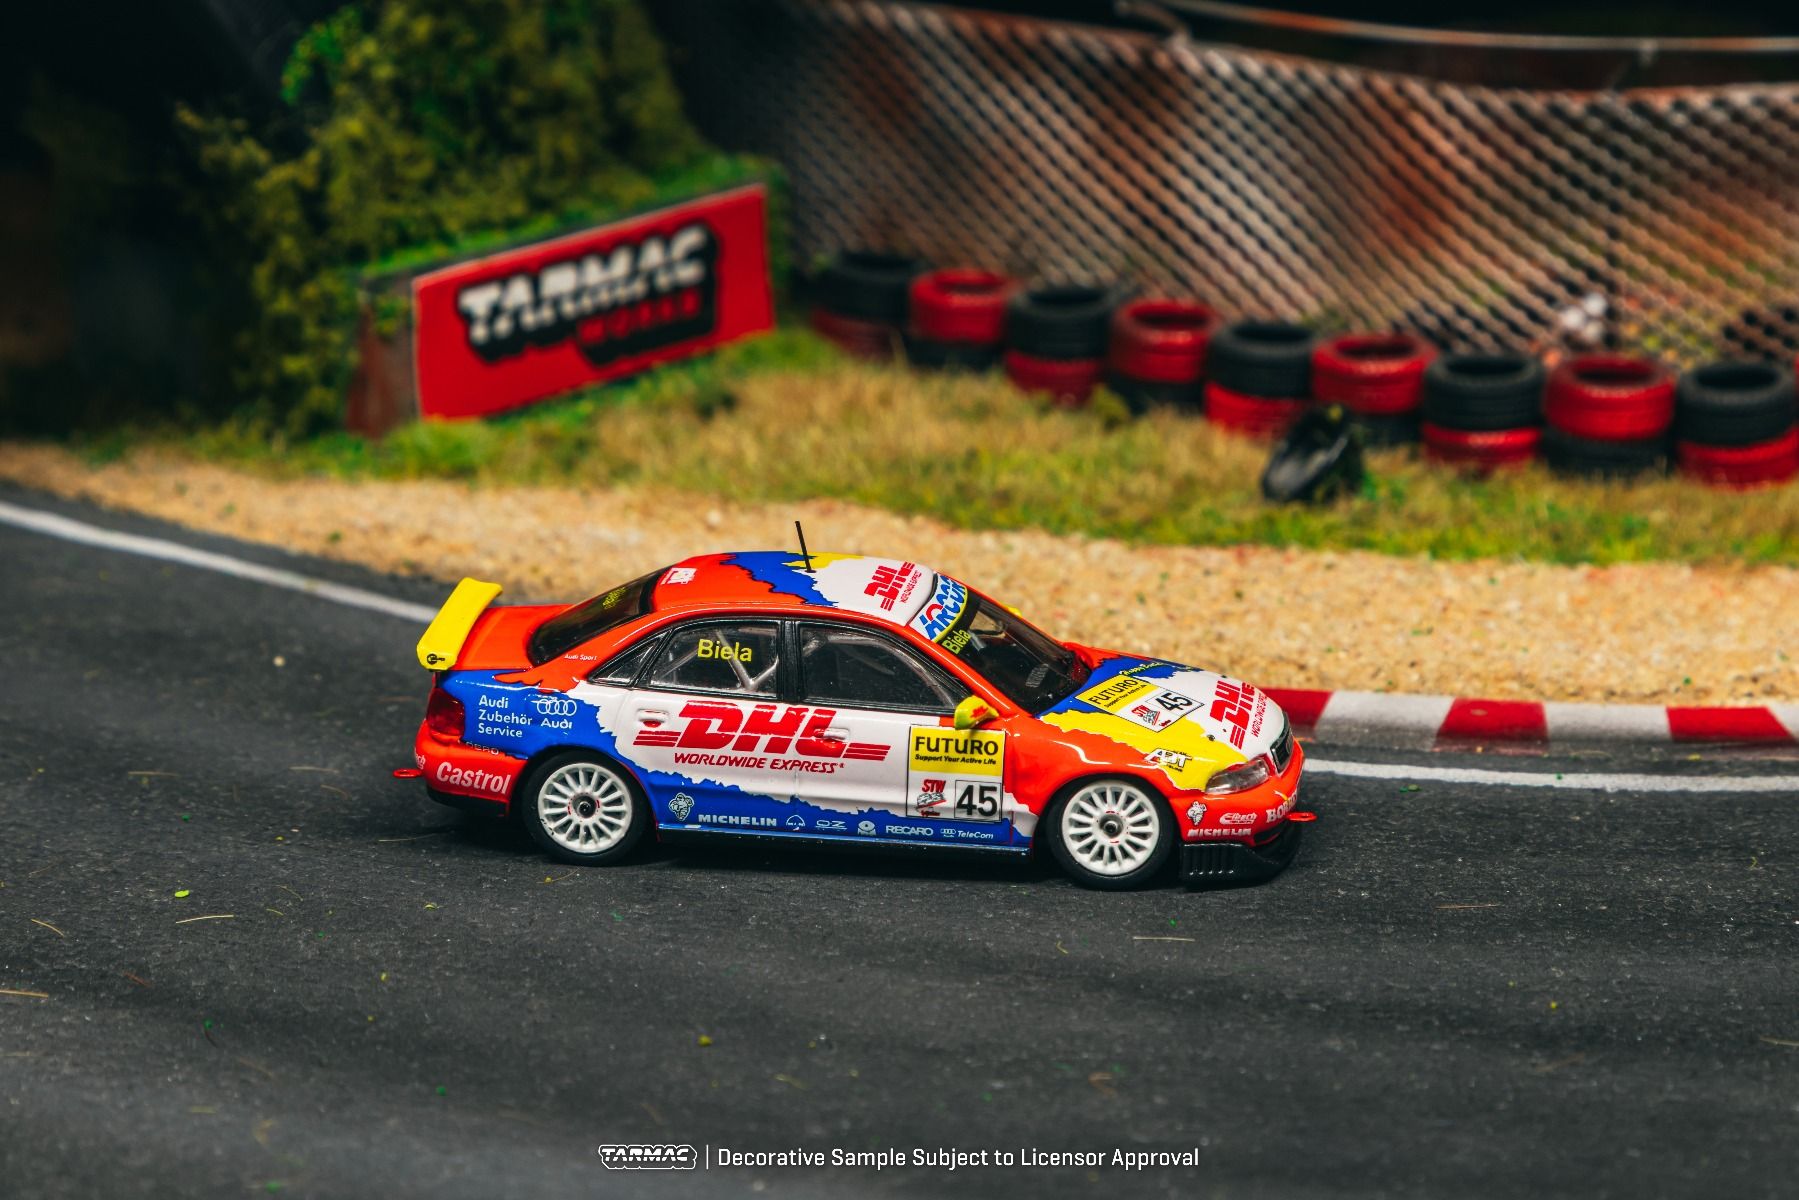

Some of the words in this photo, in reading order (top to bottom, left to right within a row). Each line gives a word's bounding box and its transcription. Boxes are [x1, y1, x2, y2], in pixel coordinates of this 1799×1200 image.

[459, 225, 708, 343] TARMAC
[697, 638, 753, 662] Biela
[942, 629, 971, 655] Biela
[1088, 679, 1139, 705] FUTURO
[479, 695, 509, 709] Audi
[1155, 692, 1193, 711] 45
[1209, 680, 1256, 730] DHL
[478, 709, 533, 726] Zubehör
[540, 717, 573, 729] Audi
[478, 723, 523, 738] Service
[675, 700, 848, 759] DHL
[915, 736, 999, 756] FUTURO
[673, 752, 768, 770] WORLDWIDE
[915, 754, 942, 764] Support
[943, 755, 959, 763] Your
[960, 756, 982, 764] Active
[983, 757, 997, 765] Life
[1144, 748, 1192, 768] ABT
[436, 761, 512, 795] Castrol
[922, 778, 946, 793] STW
[956, 784, 998, 817] 45
[698, 813, 777, 827] MICHELIN
[885, 825, 934, 836] RECARO
[957, 830, 994, 840] TeleCom
[1187, 828, 1252, 837] MICHELIN
